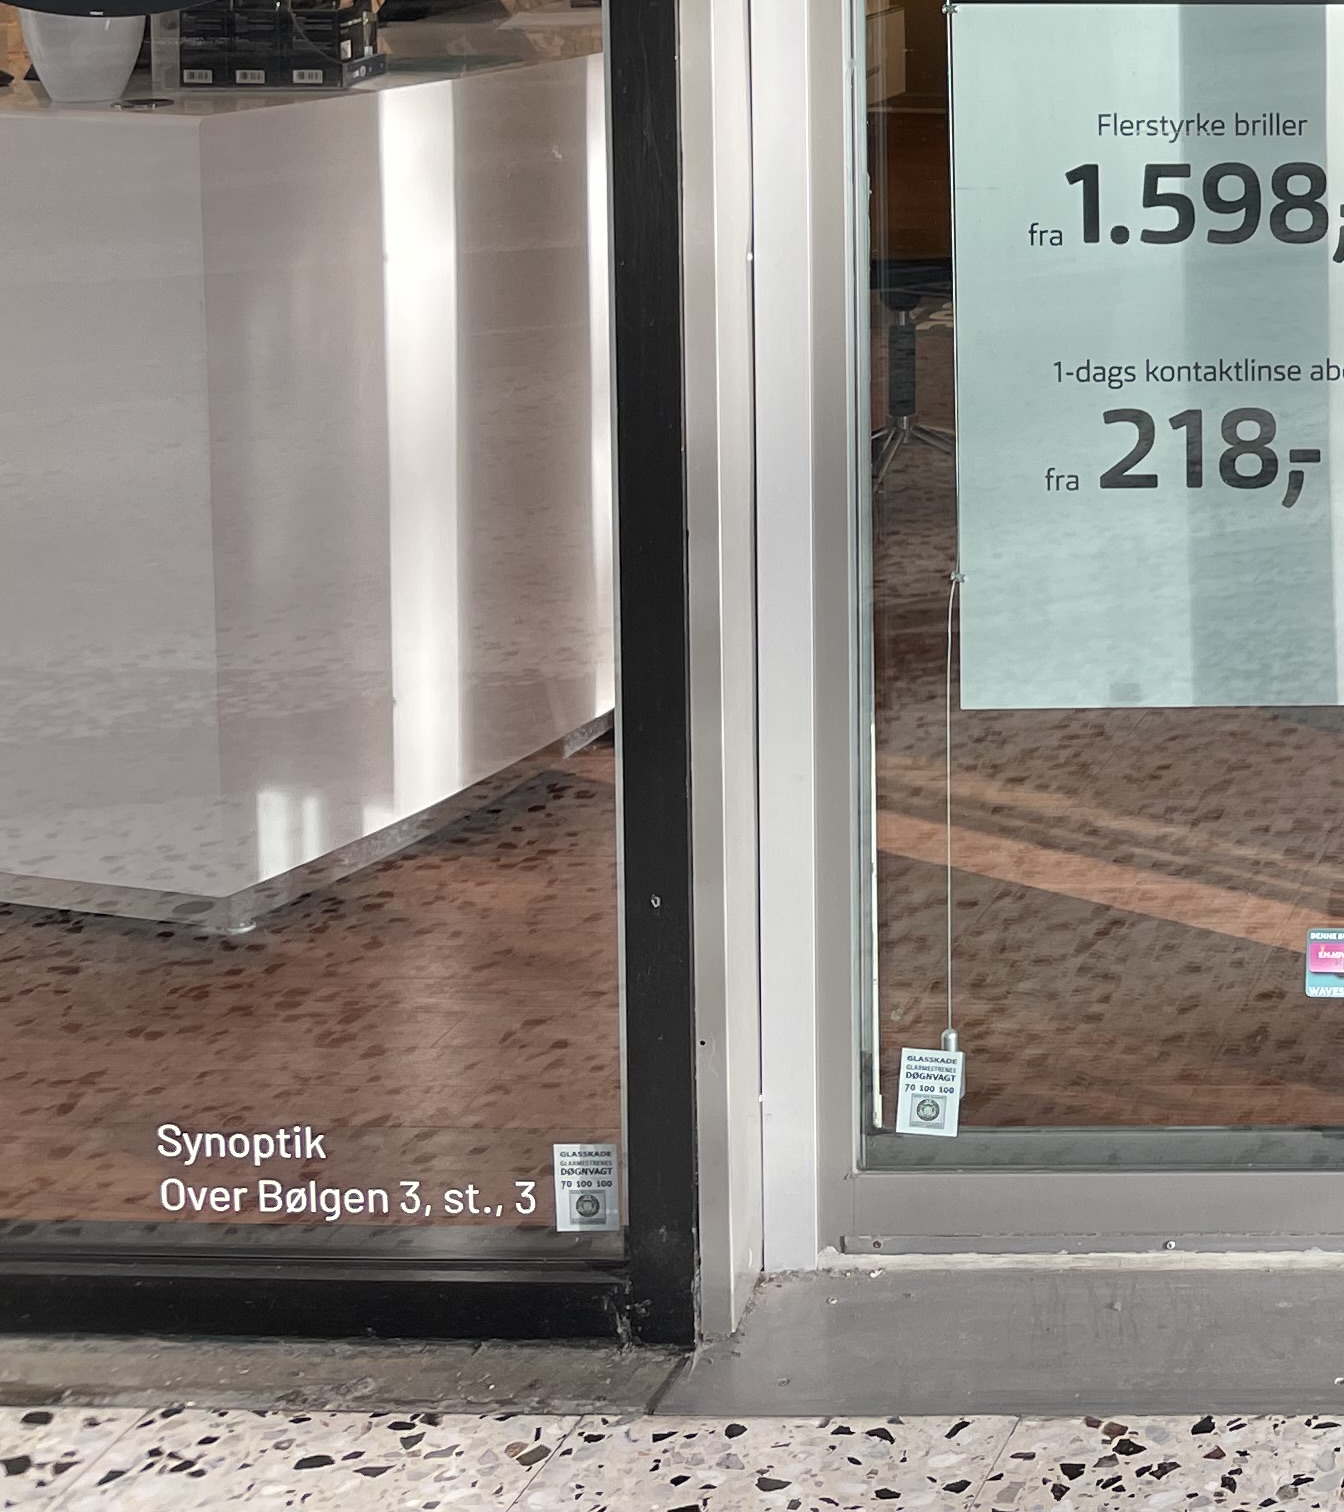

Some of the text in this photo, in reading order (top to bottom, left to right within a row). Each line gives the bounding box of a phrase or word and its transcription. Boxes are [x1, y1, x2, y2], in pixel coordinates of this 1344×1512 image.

[1097, 112, 1308, 143] Flerstyrke briller
[1028, 222, 1063, 246] fra
[1053, 359, 1136, 389] 1-dags
[1145, 358, 1302, 383] kontaktlinse
[1045, 407, 1322, 509] fra 218,-
[907, 1055, 957, 1064] GLASSKADE
[905, 1083, 954, 1094] 70 100 100
[906, 1071, 956, 1082] DØGNVAGT
[157, 1124, 326, 1166] Synoptik
[560, 1168, 613, 1176] DØGNVAGT
[561, 1180, 613, 1189] 70 100 100
[160, 1178, 537, 1221] Over Bølgen 3, st., 3
